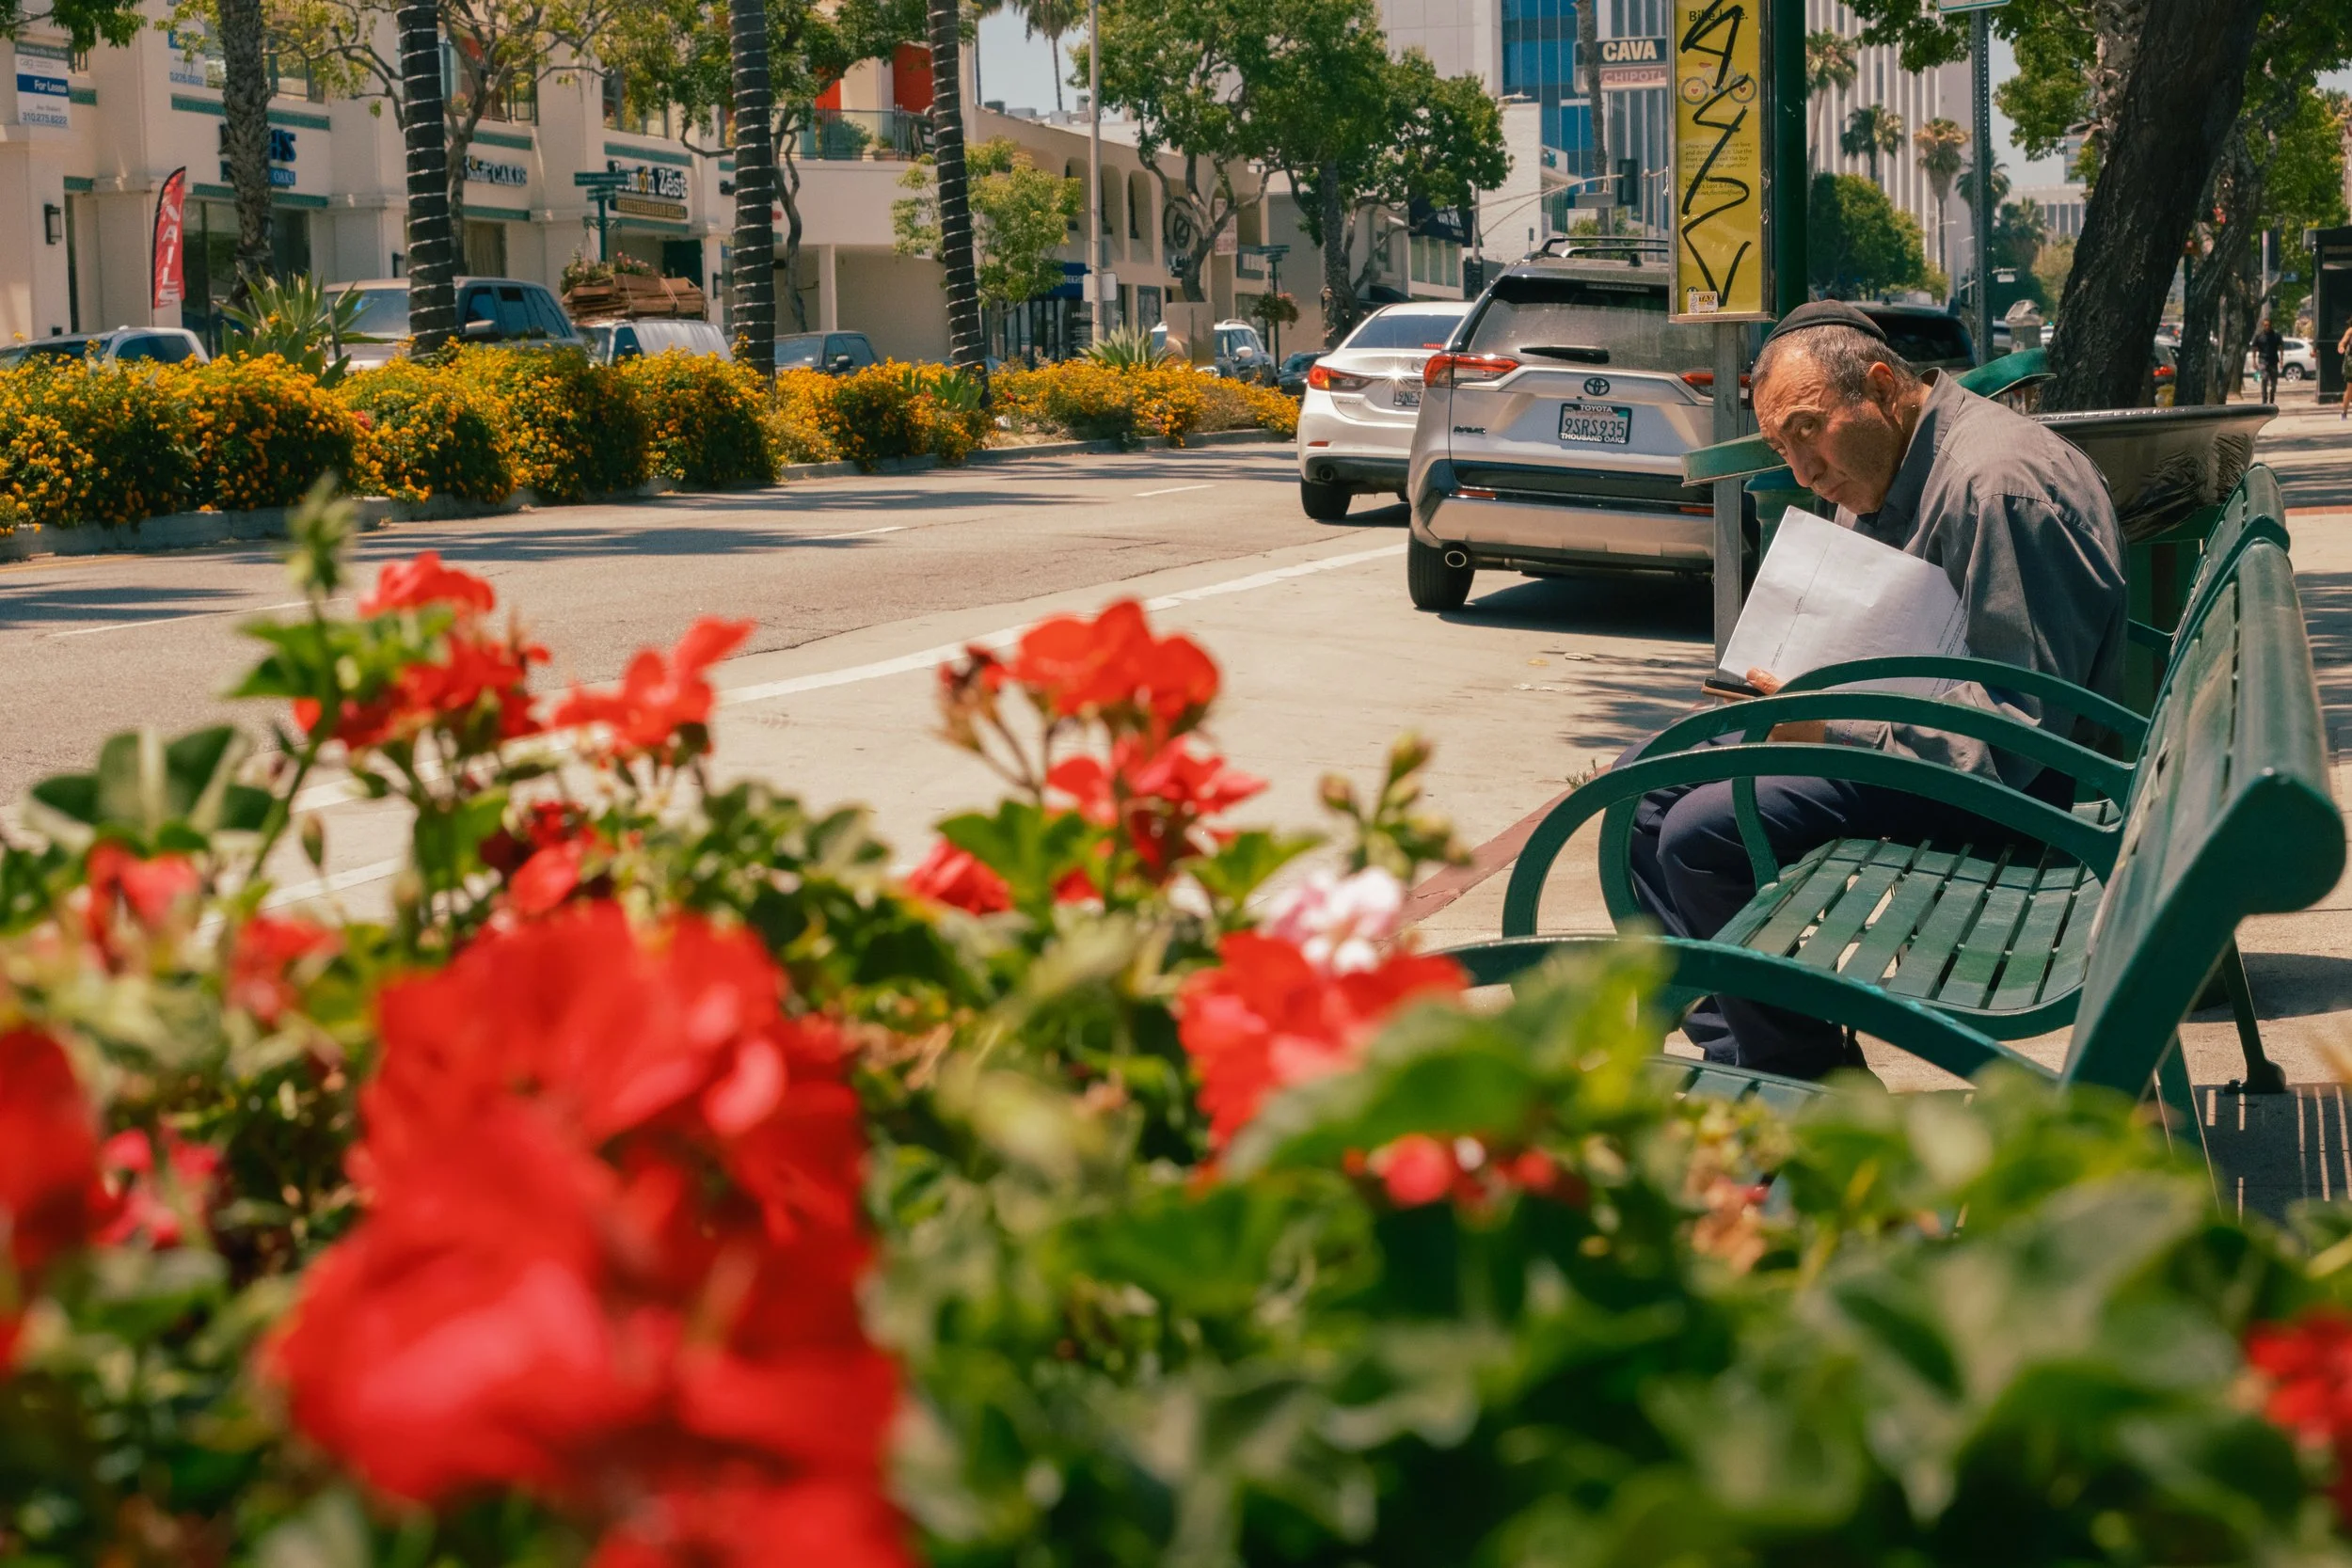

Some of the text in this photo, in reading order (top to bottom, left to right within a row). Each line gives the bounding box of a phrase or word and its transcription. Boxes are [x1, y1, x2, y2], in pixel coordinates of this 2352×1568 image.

[1602, 40, 1657, 62] CAVA
[34, 79, 67, 93] For Lease
[1603, 70, 1665, 83] CHIPOTL
[492, 165, 527, 188] CAKES
[158, 193, 181, 308] NAILS
[1565, 418, 1625, 437] 9SRS935
[1561, 433, 1602, 442] THOUSAND
